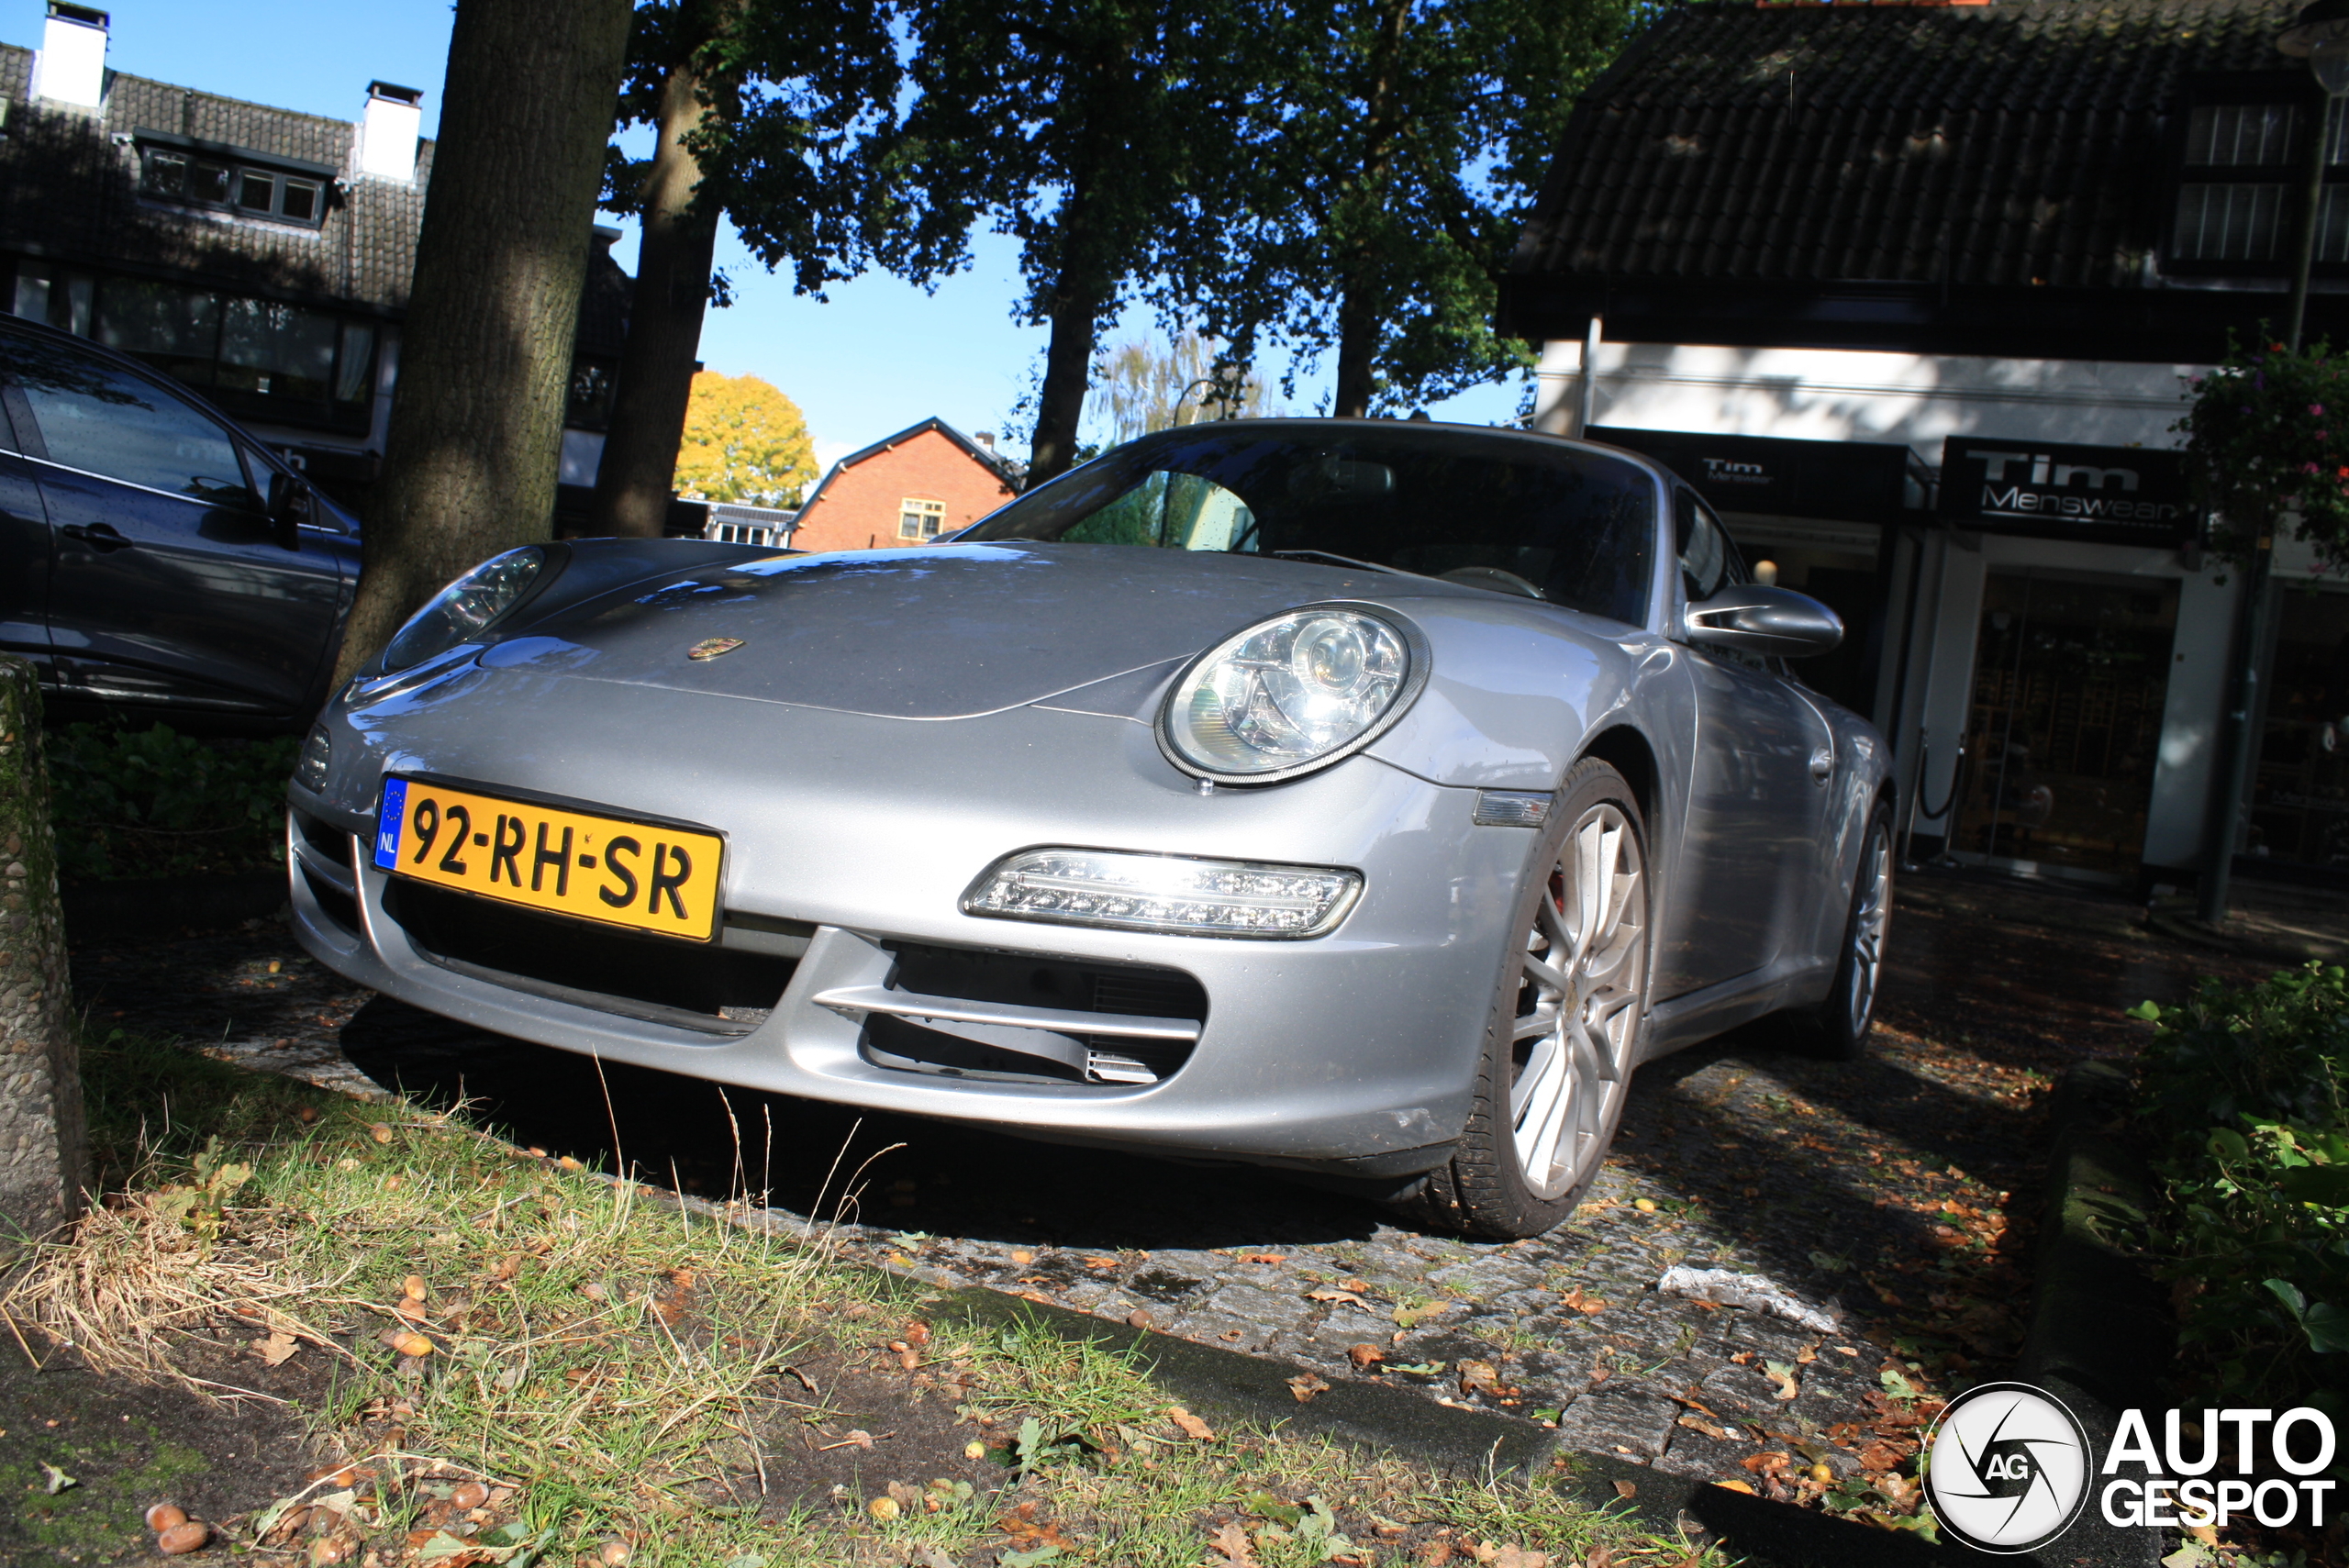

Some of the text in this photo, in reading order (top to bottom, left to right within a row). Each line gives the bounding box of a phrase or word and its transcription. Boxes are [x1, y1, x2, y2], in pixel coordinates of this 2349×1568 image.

[1702, 457, 1764, 475] Tim
[1965, 449, 2141, 492] Tim
[1981, 484, 2177, 521] Menswear
[380, 831, 396, 855] NL
[413, 797, 693, 919] 92-RH-SR
